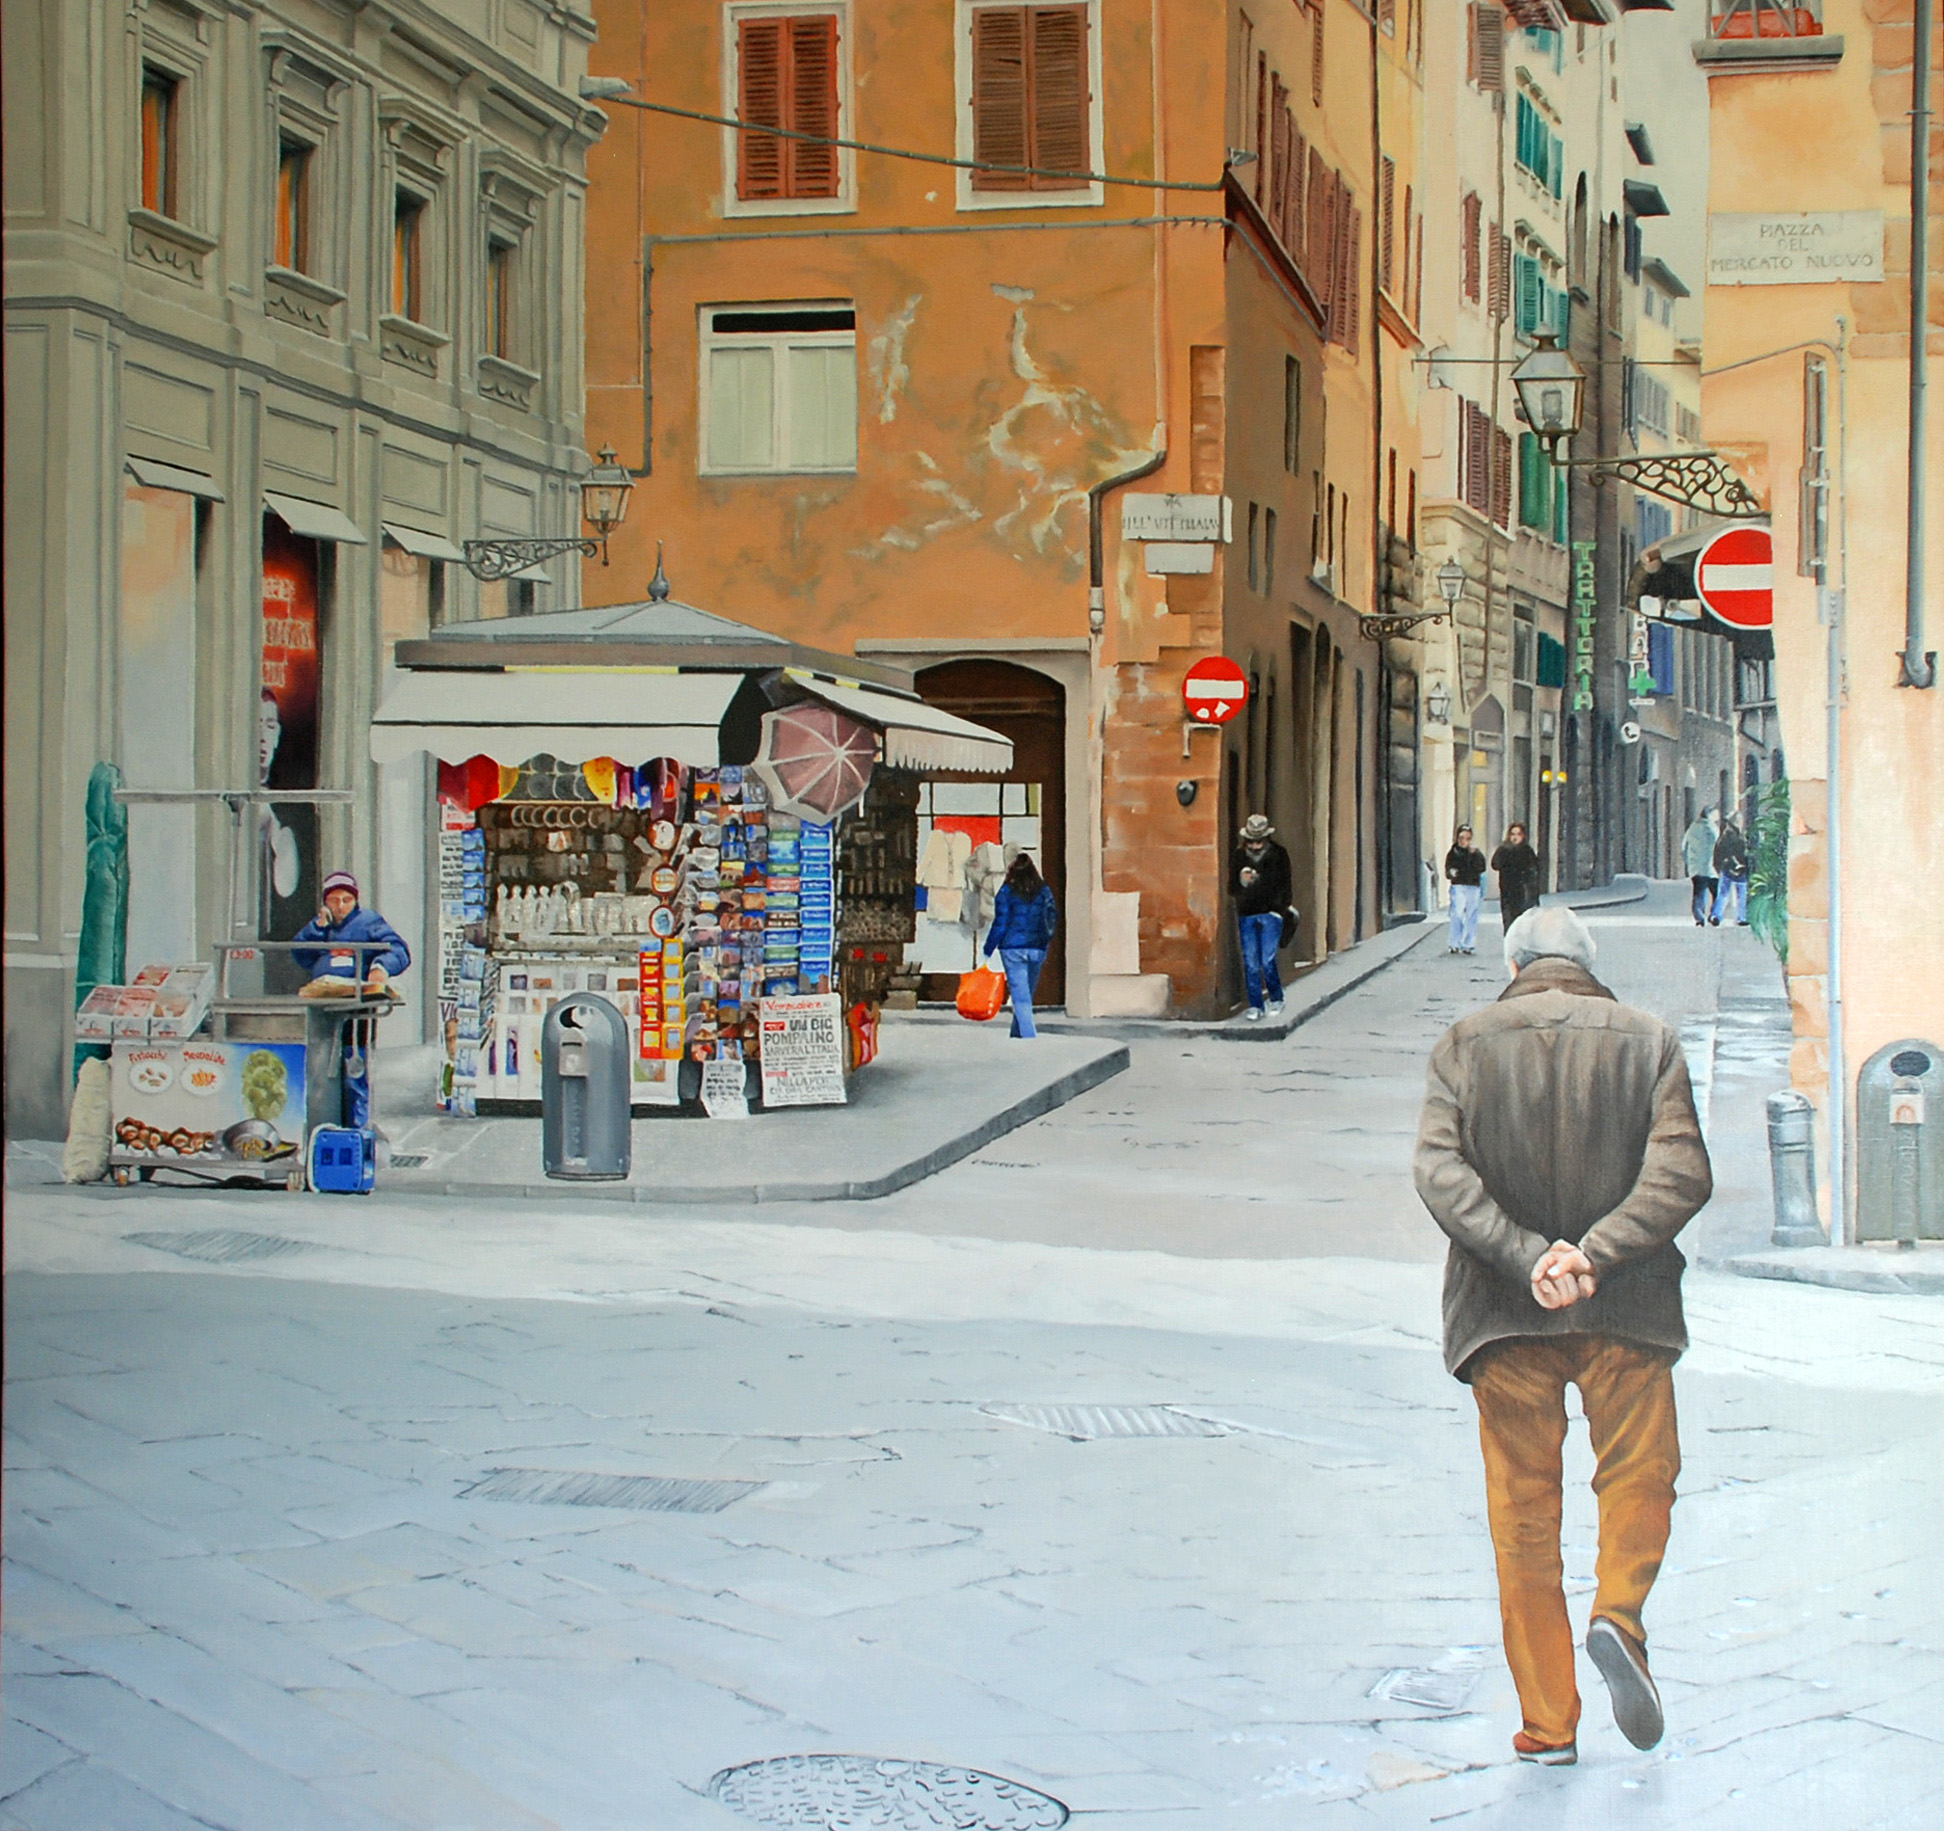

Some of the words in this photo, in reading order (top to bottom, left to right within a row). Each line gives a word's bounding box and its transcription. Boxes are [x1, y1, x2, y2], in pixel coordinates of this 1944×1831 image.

[1760, 223, 1824, 238] PIAZZA
[1711, 256, 1793, 272] MERCATO
[1806, 253, 1873, 269] NUOVO
[1573, 541, 1597, 711] TRATTORIA
